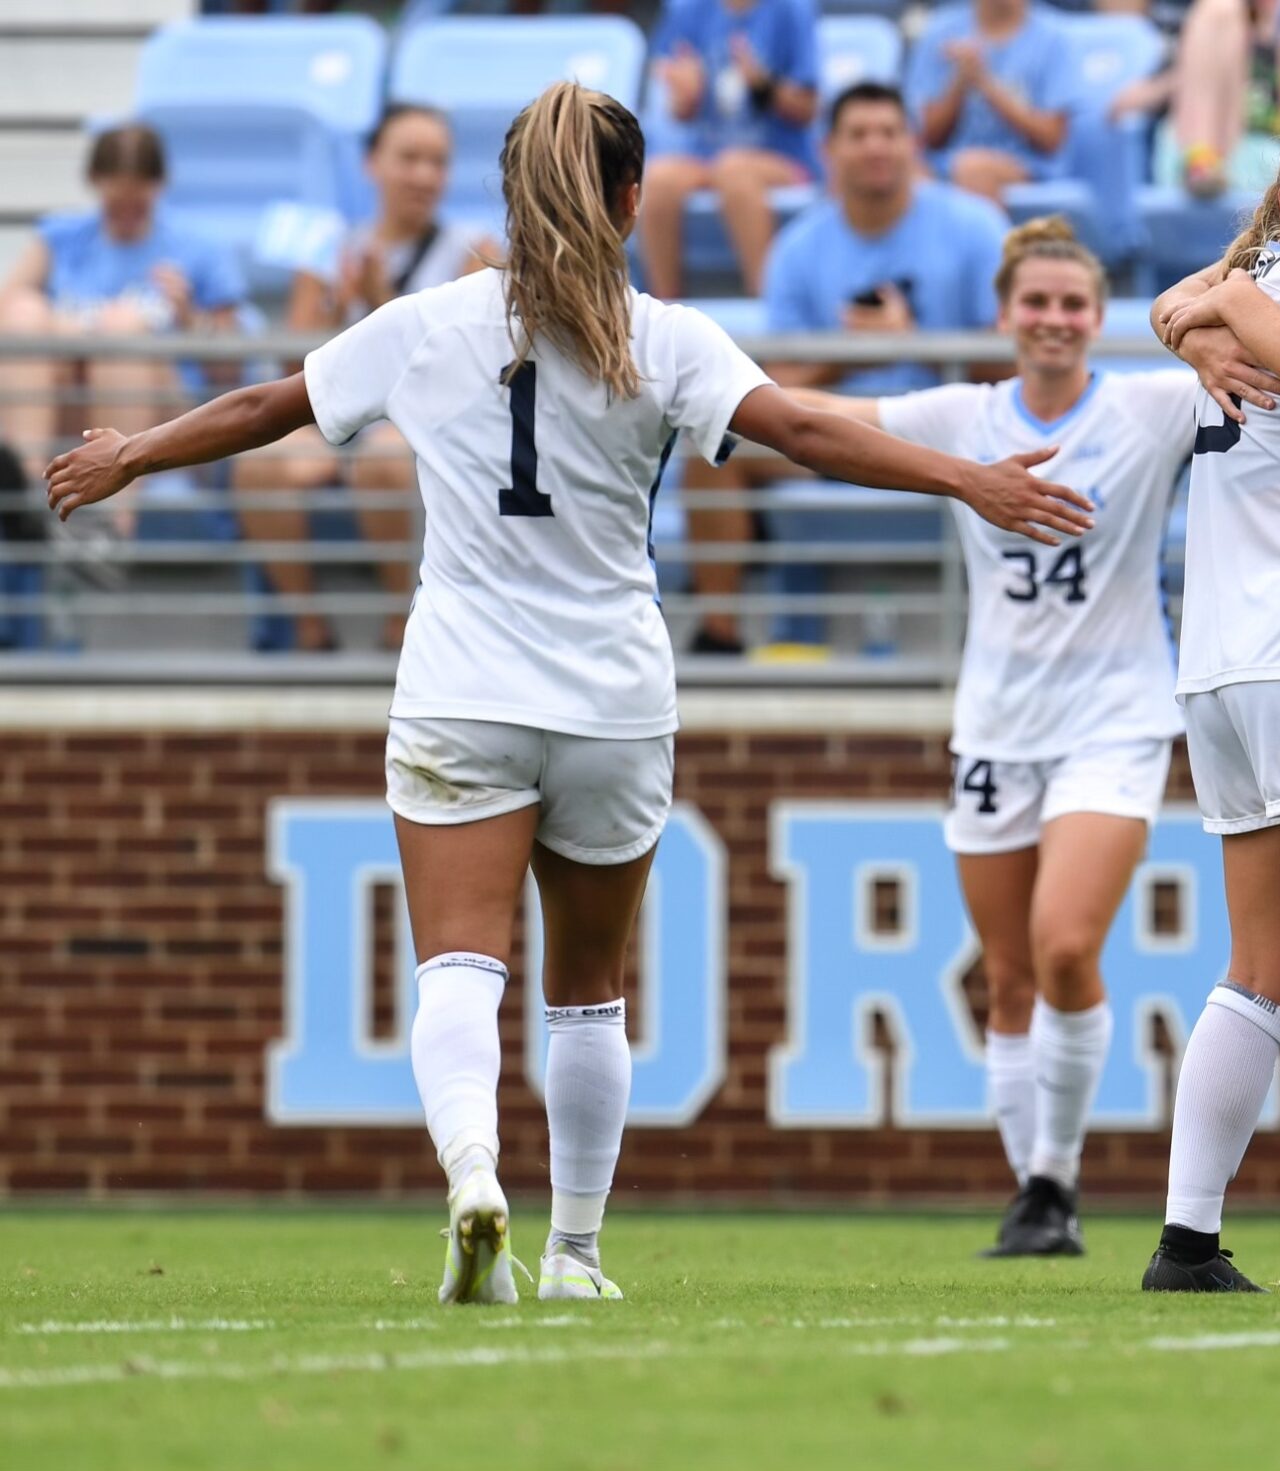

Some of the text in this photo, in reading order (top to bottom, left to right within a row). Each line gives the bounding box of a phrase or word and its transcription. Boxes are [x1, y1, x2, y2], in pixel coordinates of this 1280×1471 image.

[498, 360, 555, 517] 1
[1002, 546, 1086, 602] 34
[954, 755, 997, 812] 4
